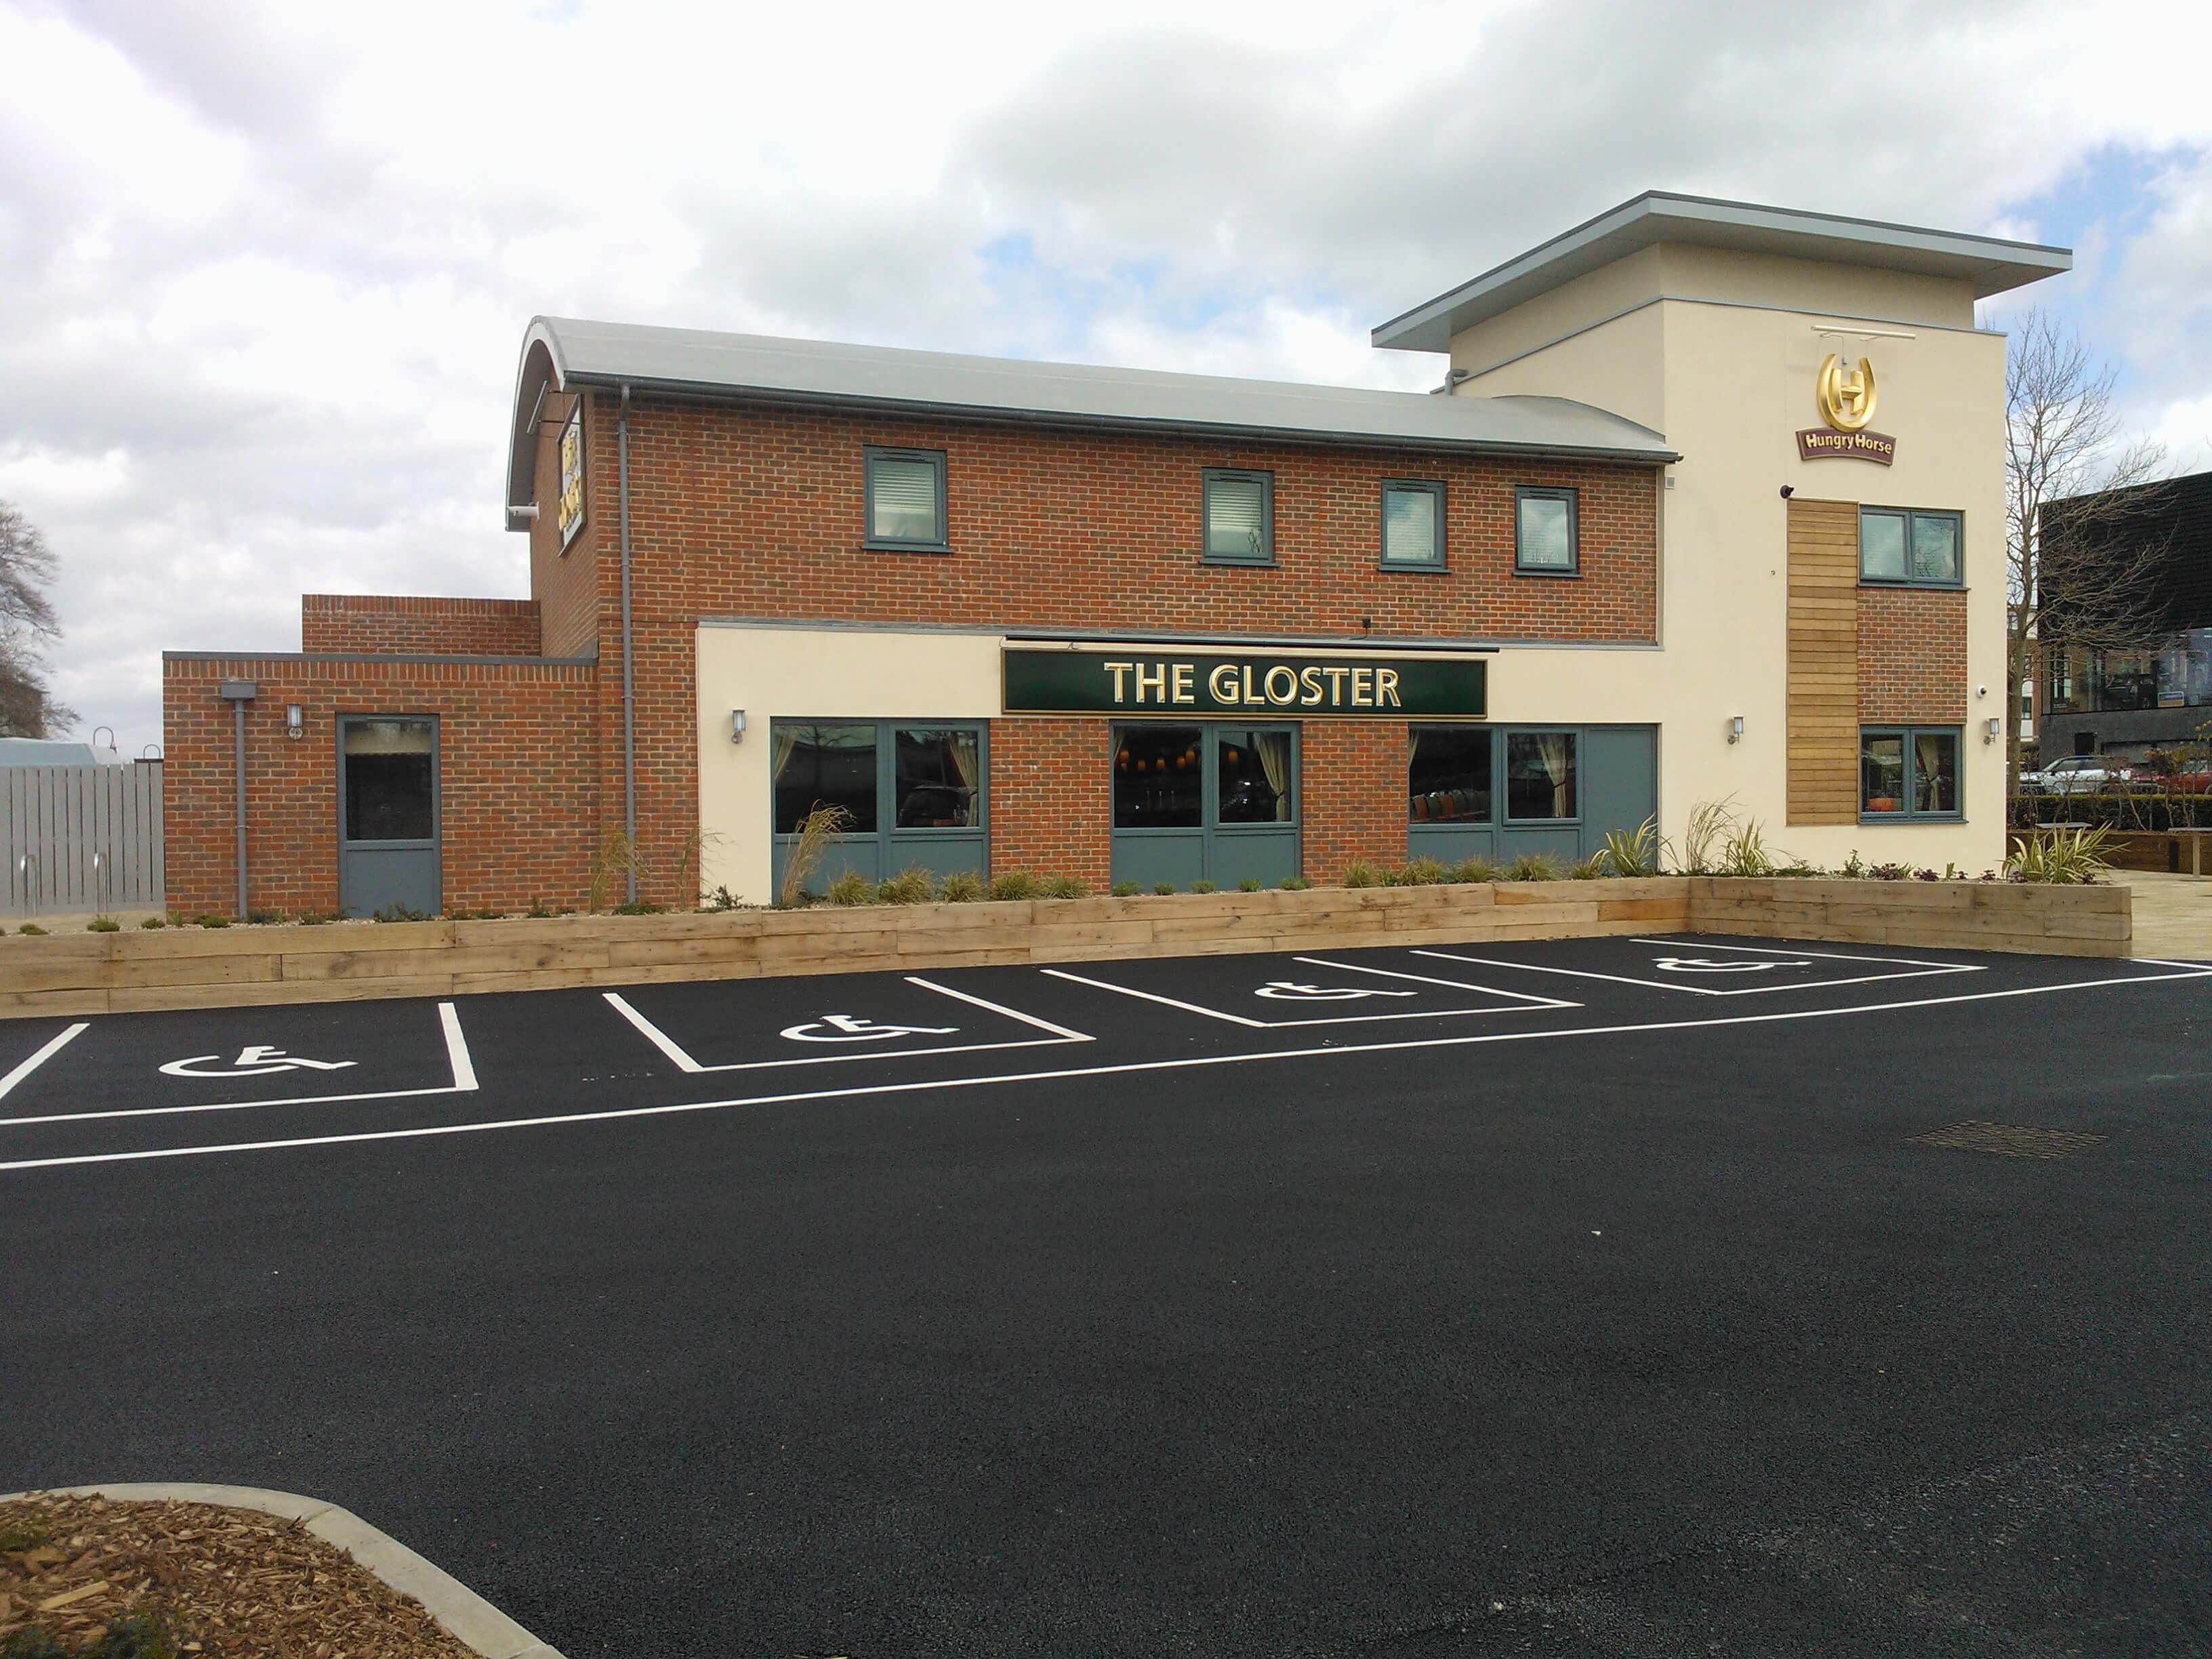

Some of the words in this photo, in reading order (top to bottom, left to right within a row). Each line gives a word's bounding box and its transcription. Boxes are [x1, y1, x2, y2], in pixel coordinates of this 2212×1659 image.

[1805, 433, 1853, 450] Hungry
[1854, 433, 1892, 454] Horse
[1104, 662, 1195, 703] THE
[1208, 664, 1401, 707] GLOSTER
